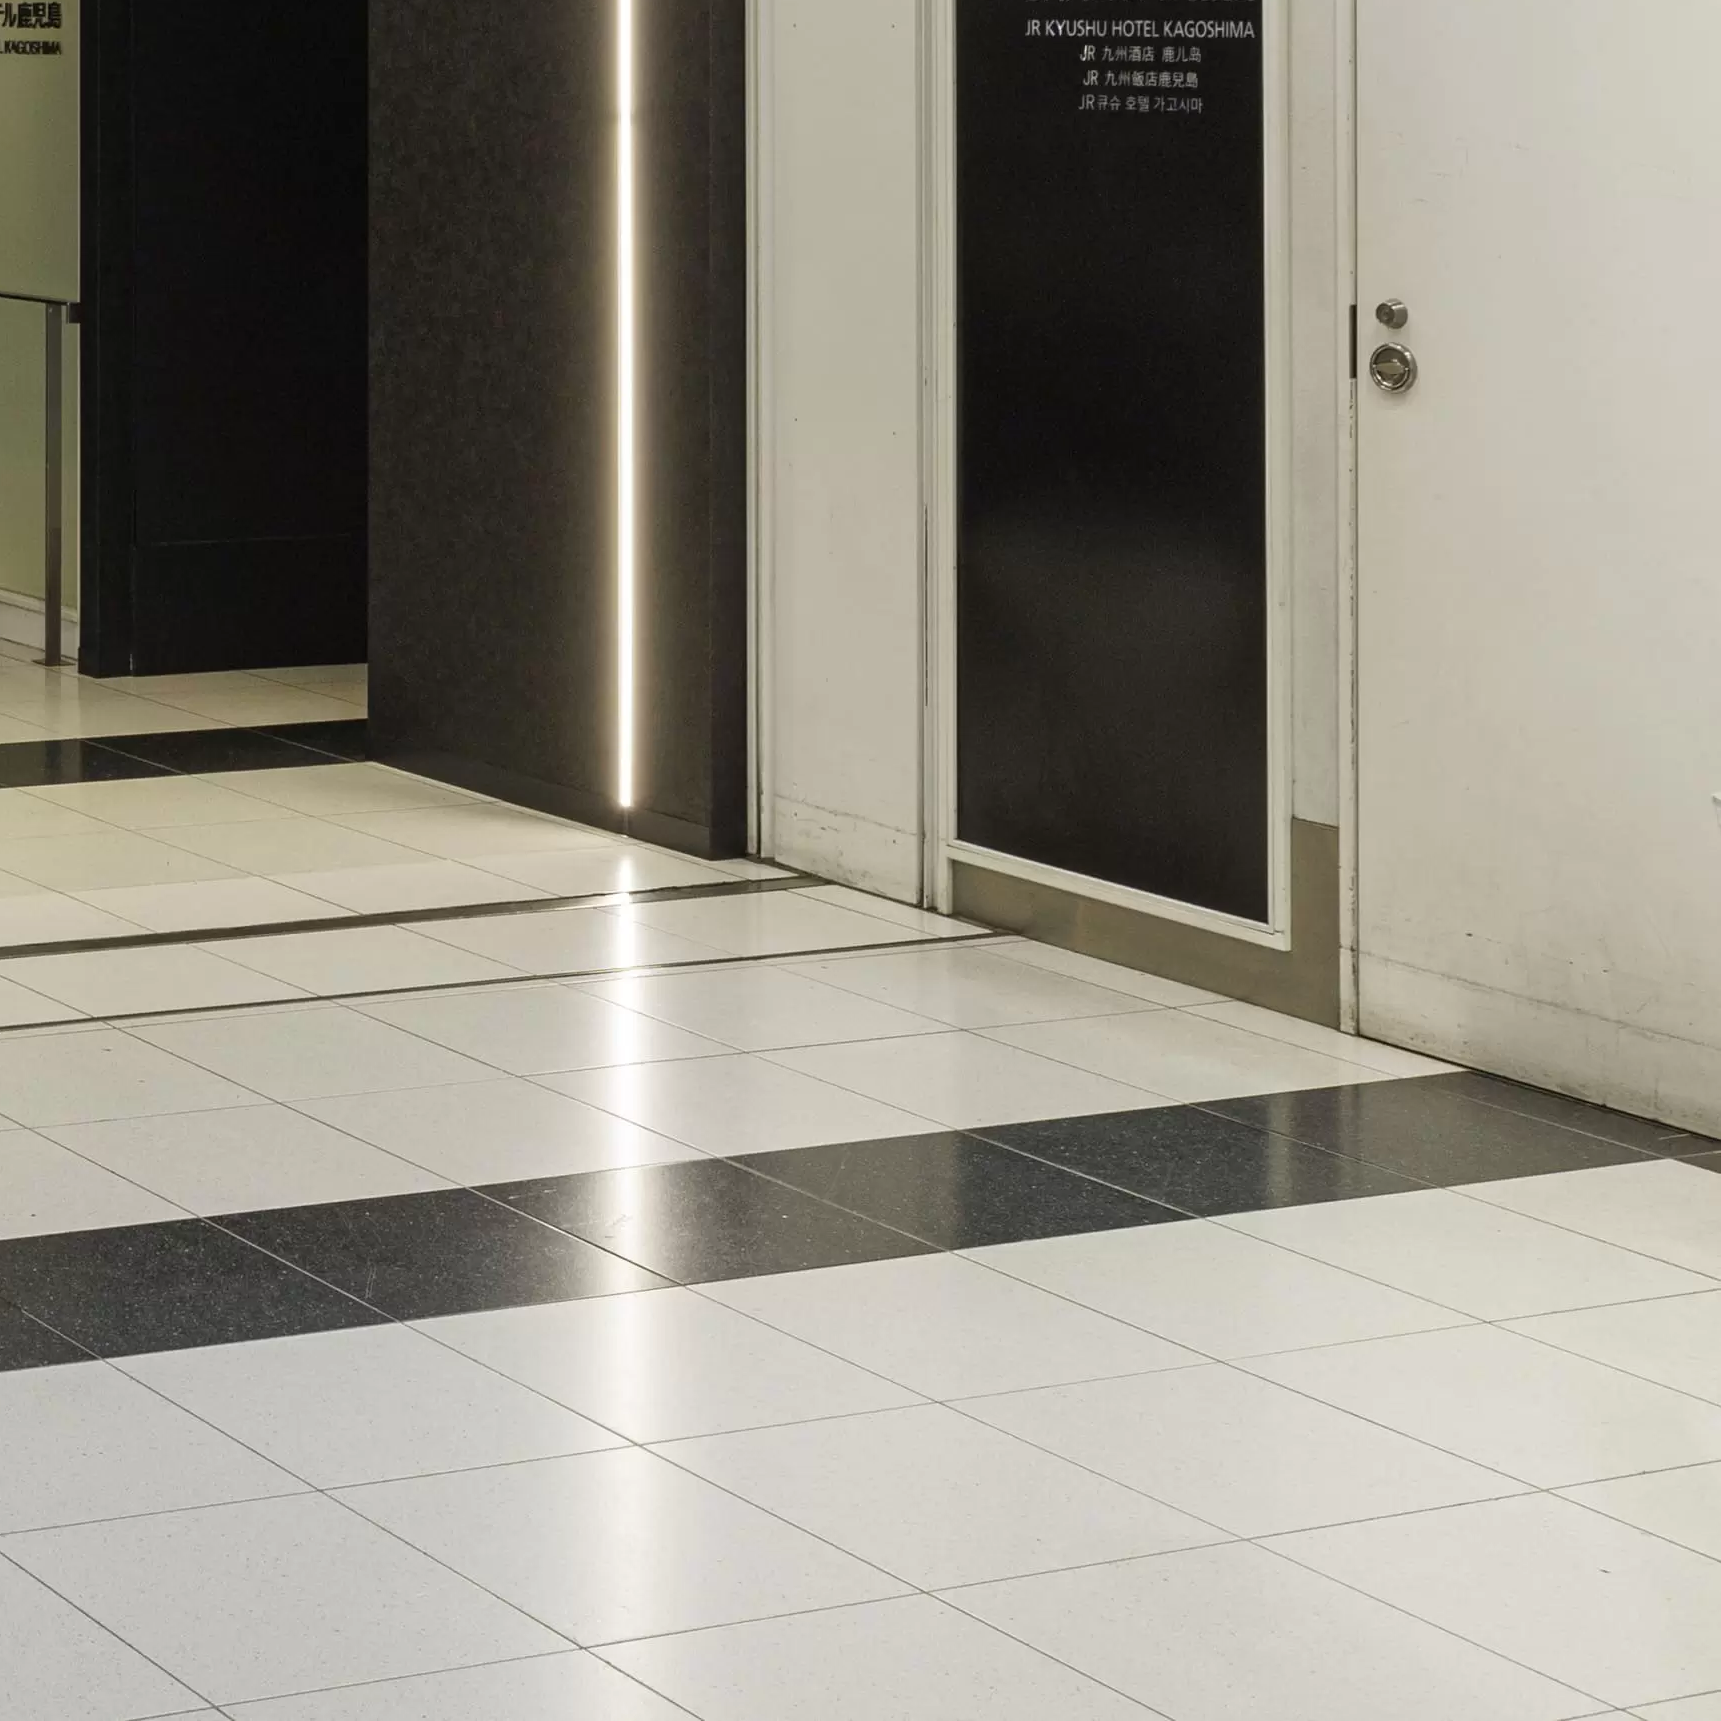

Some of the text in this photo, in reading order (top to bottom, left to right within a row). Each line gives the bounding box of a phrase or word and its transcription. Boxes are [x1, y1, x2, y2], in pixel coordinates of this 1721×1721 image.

[1025, 19, 1256, 39] JR KYUSHU HOTEL KAGOSHIMA
[4, 40, 62, 55] KAGOSHIMA
[1079, 44, 1096, 62] JR
[1101, 45, 1155, 63] 九州酒店
[1082, 70, 1099, 87] JR
